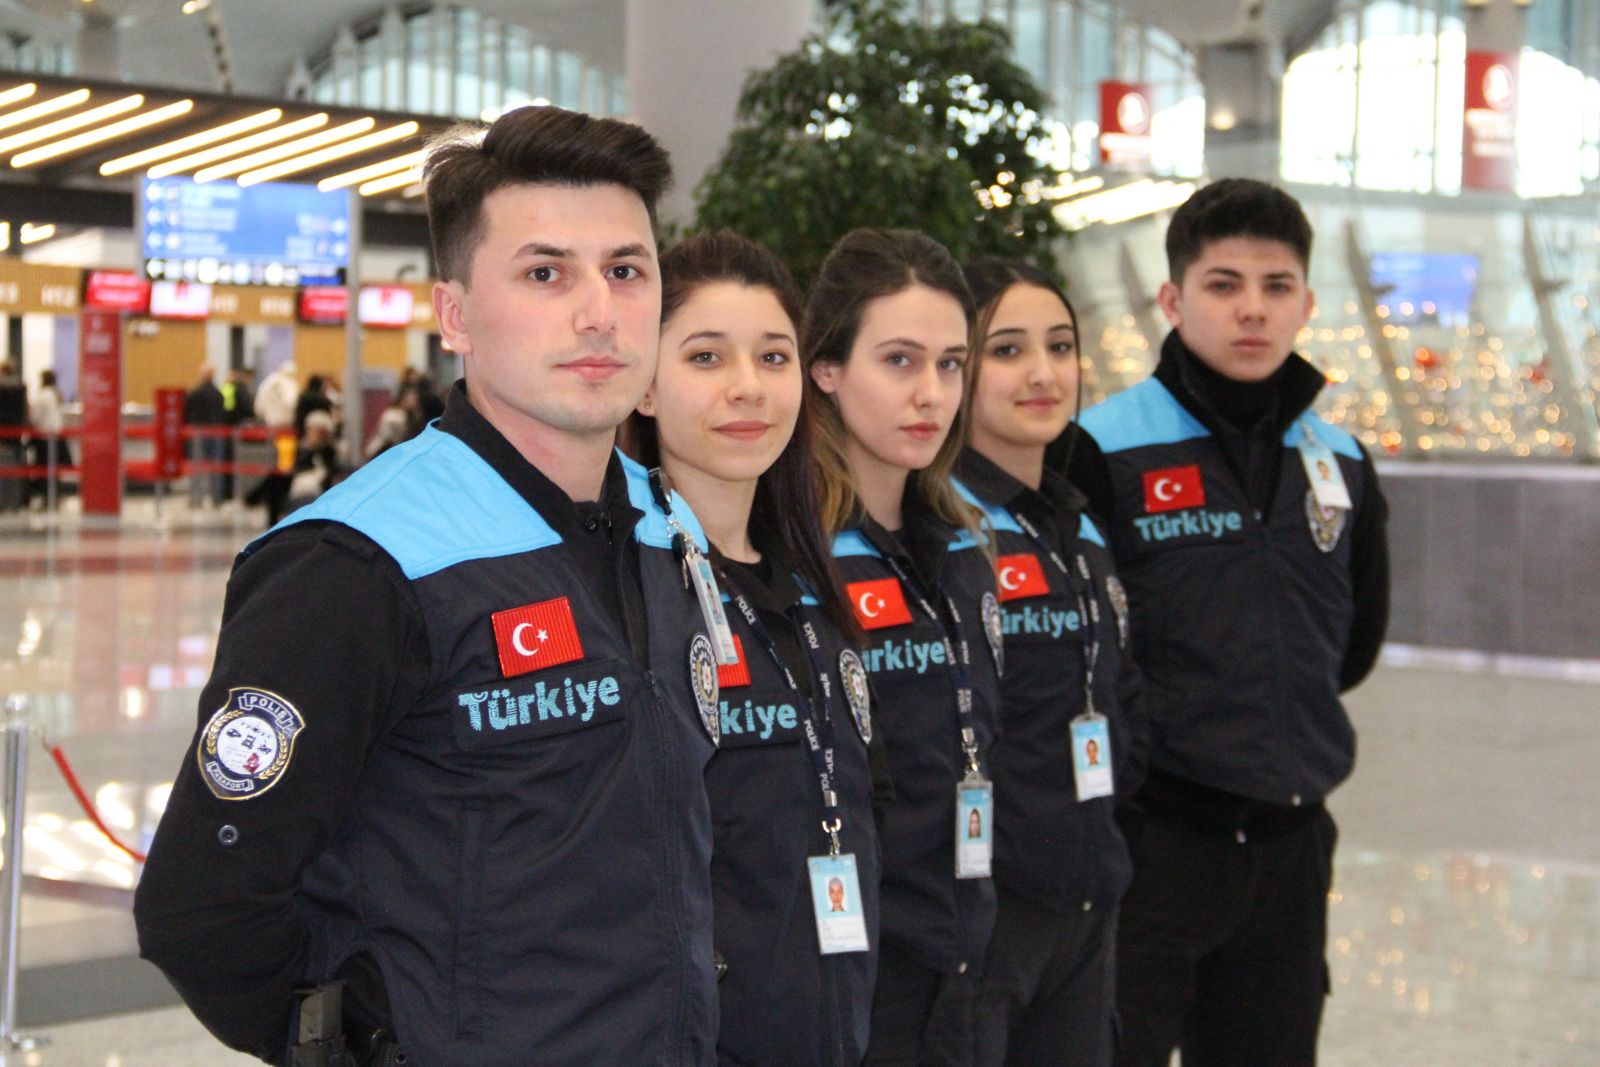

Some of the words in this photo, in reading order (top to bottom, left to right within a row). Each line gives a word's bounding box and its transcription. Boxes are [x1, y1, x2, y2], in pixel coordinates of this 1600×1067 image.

[1134, 509, 1242, 541] Türkiye
[1000, 606, 1079, 639] rkiye
[861, 639, 945, 674] rkiye
[458, 676, 621, 732] Türkiye
[719, 700, 798, 740] kiye
